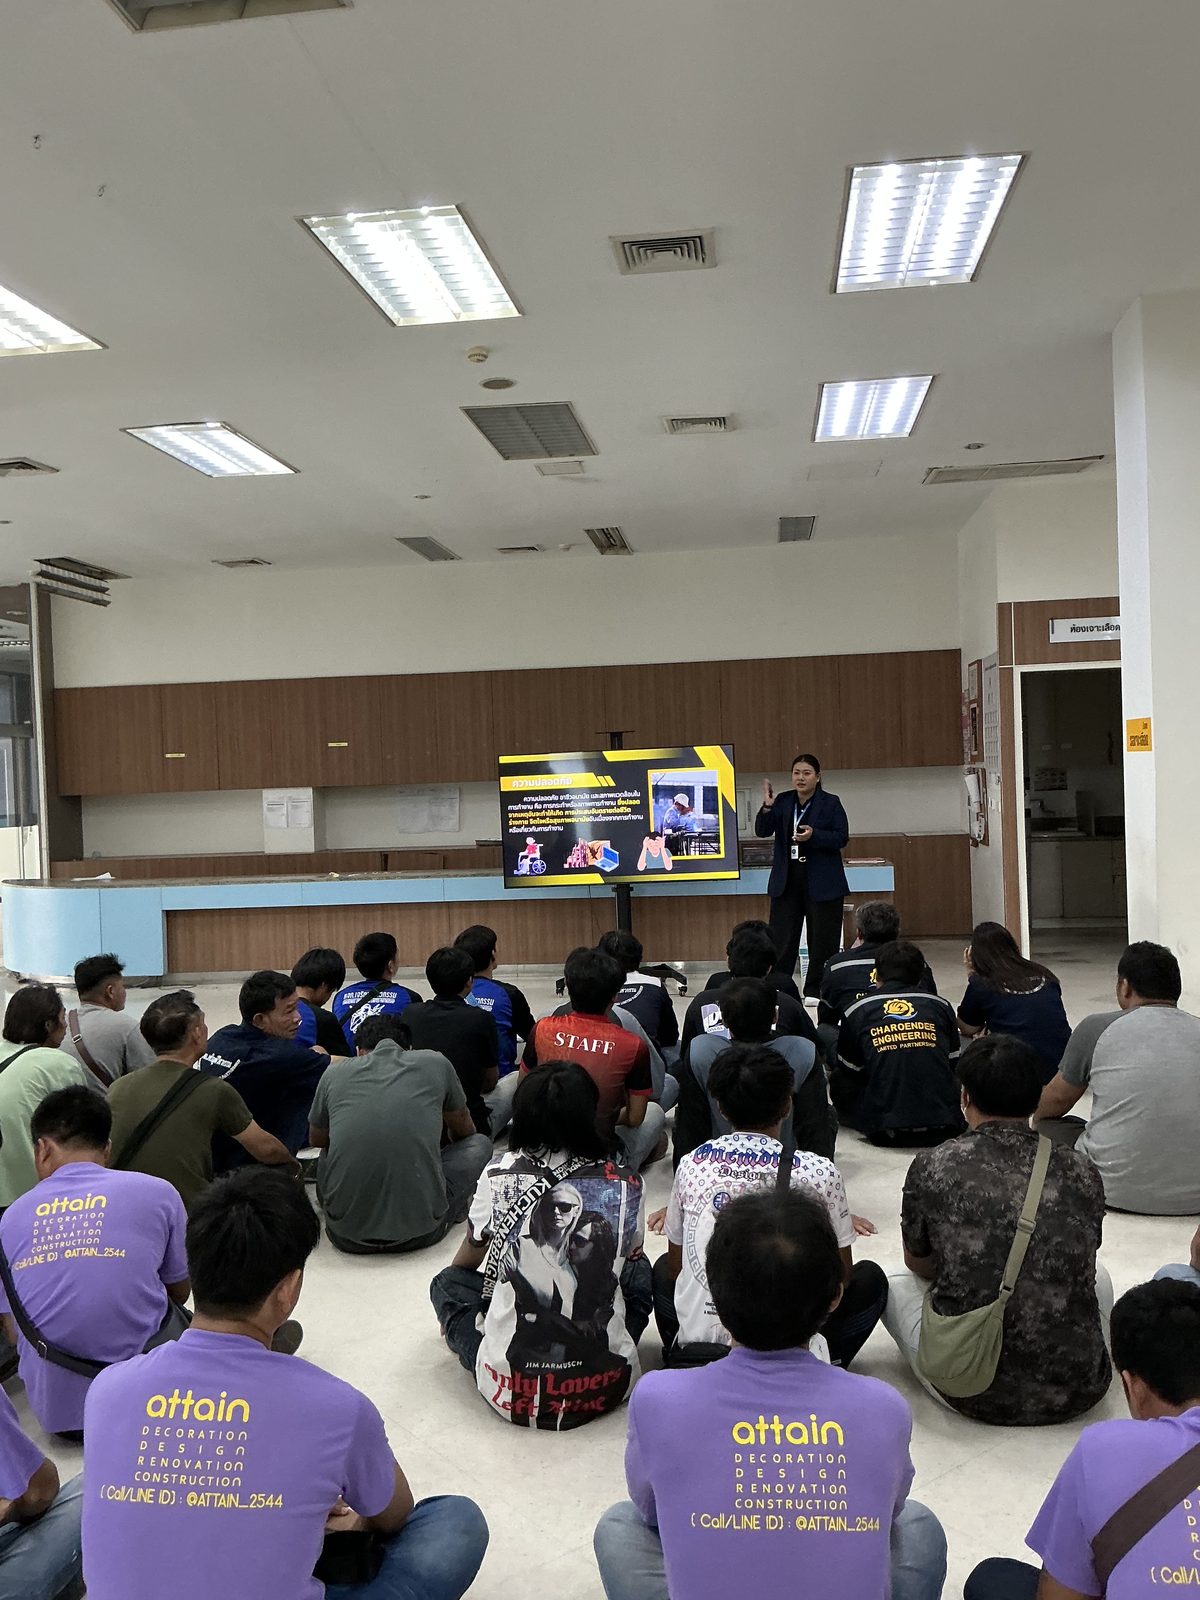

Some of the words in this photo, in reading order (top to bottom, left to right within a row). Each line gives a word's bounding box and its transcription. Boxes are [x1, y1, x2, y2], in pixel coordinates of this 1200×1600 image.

[870, 1022, 936, 1036] CHAROENDEE
[554, 1032, 615, 1055] STAFF
[872, 1031, 937, 1047] ENGINEERING
[876, 1044, 898, 1053] LIMITED
[36, 1193, 107, 1217] attain
[525, 1361, 540, 1369] JIM
[541, 1360, 583, 1370] JARMUSCH
[146, 1389, 251, 1423] attain
[732, 1413, 844, 1446] attain
[186, 1491, 284, 1508] @ATTAIN_2544
[795, 1515, 880, 1532] @ATTAIN_2544
